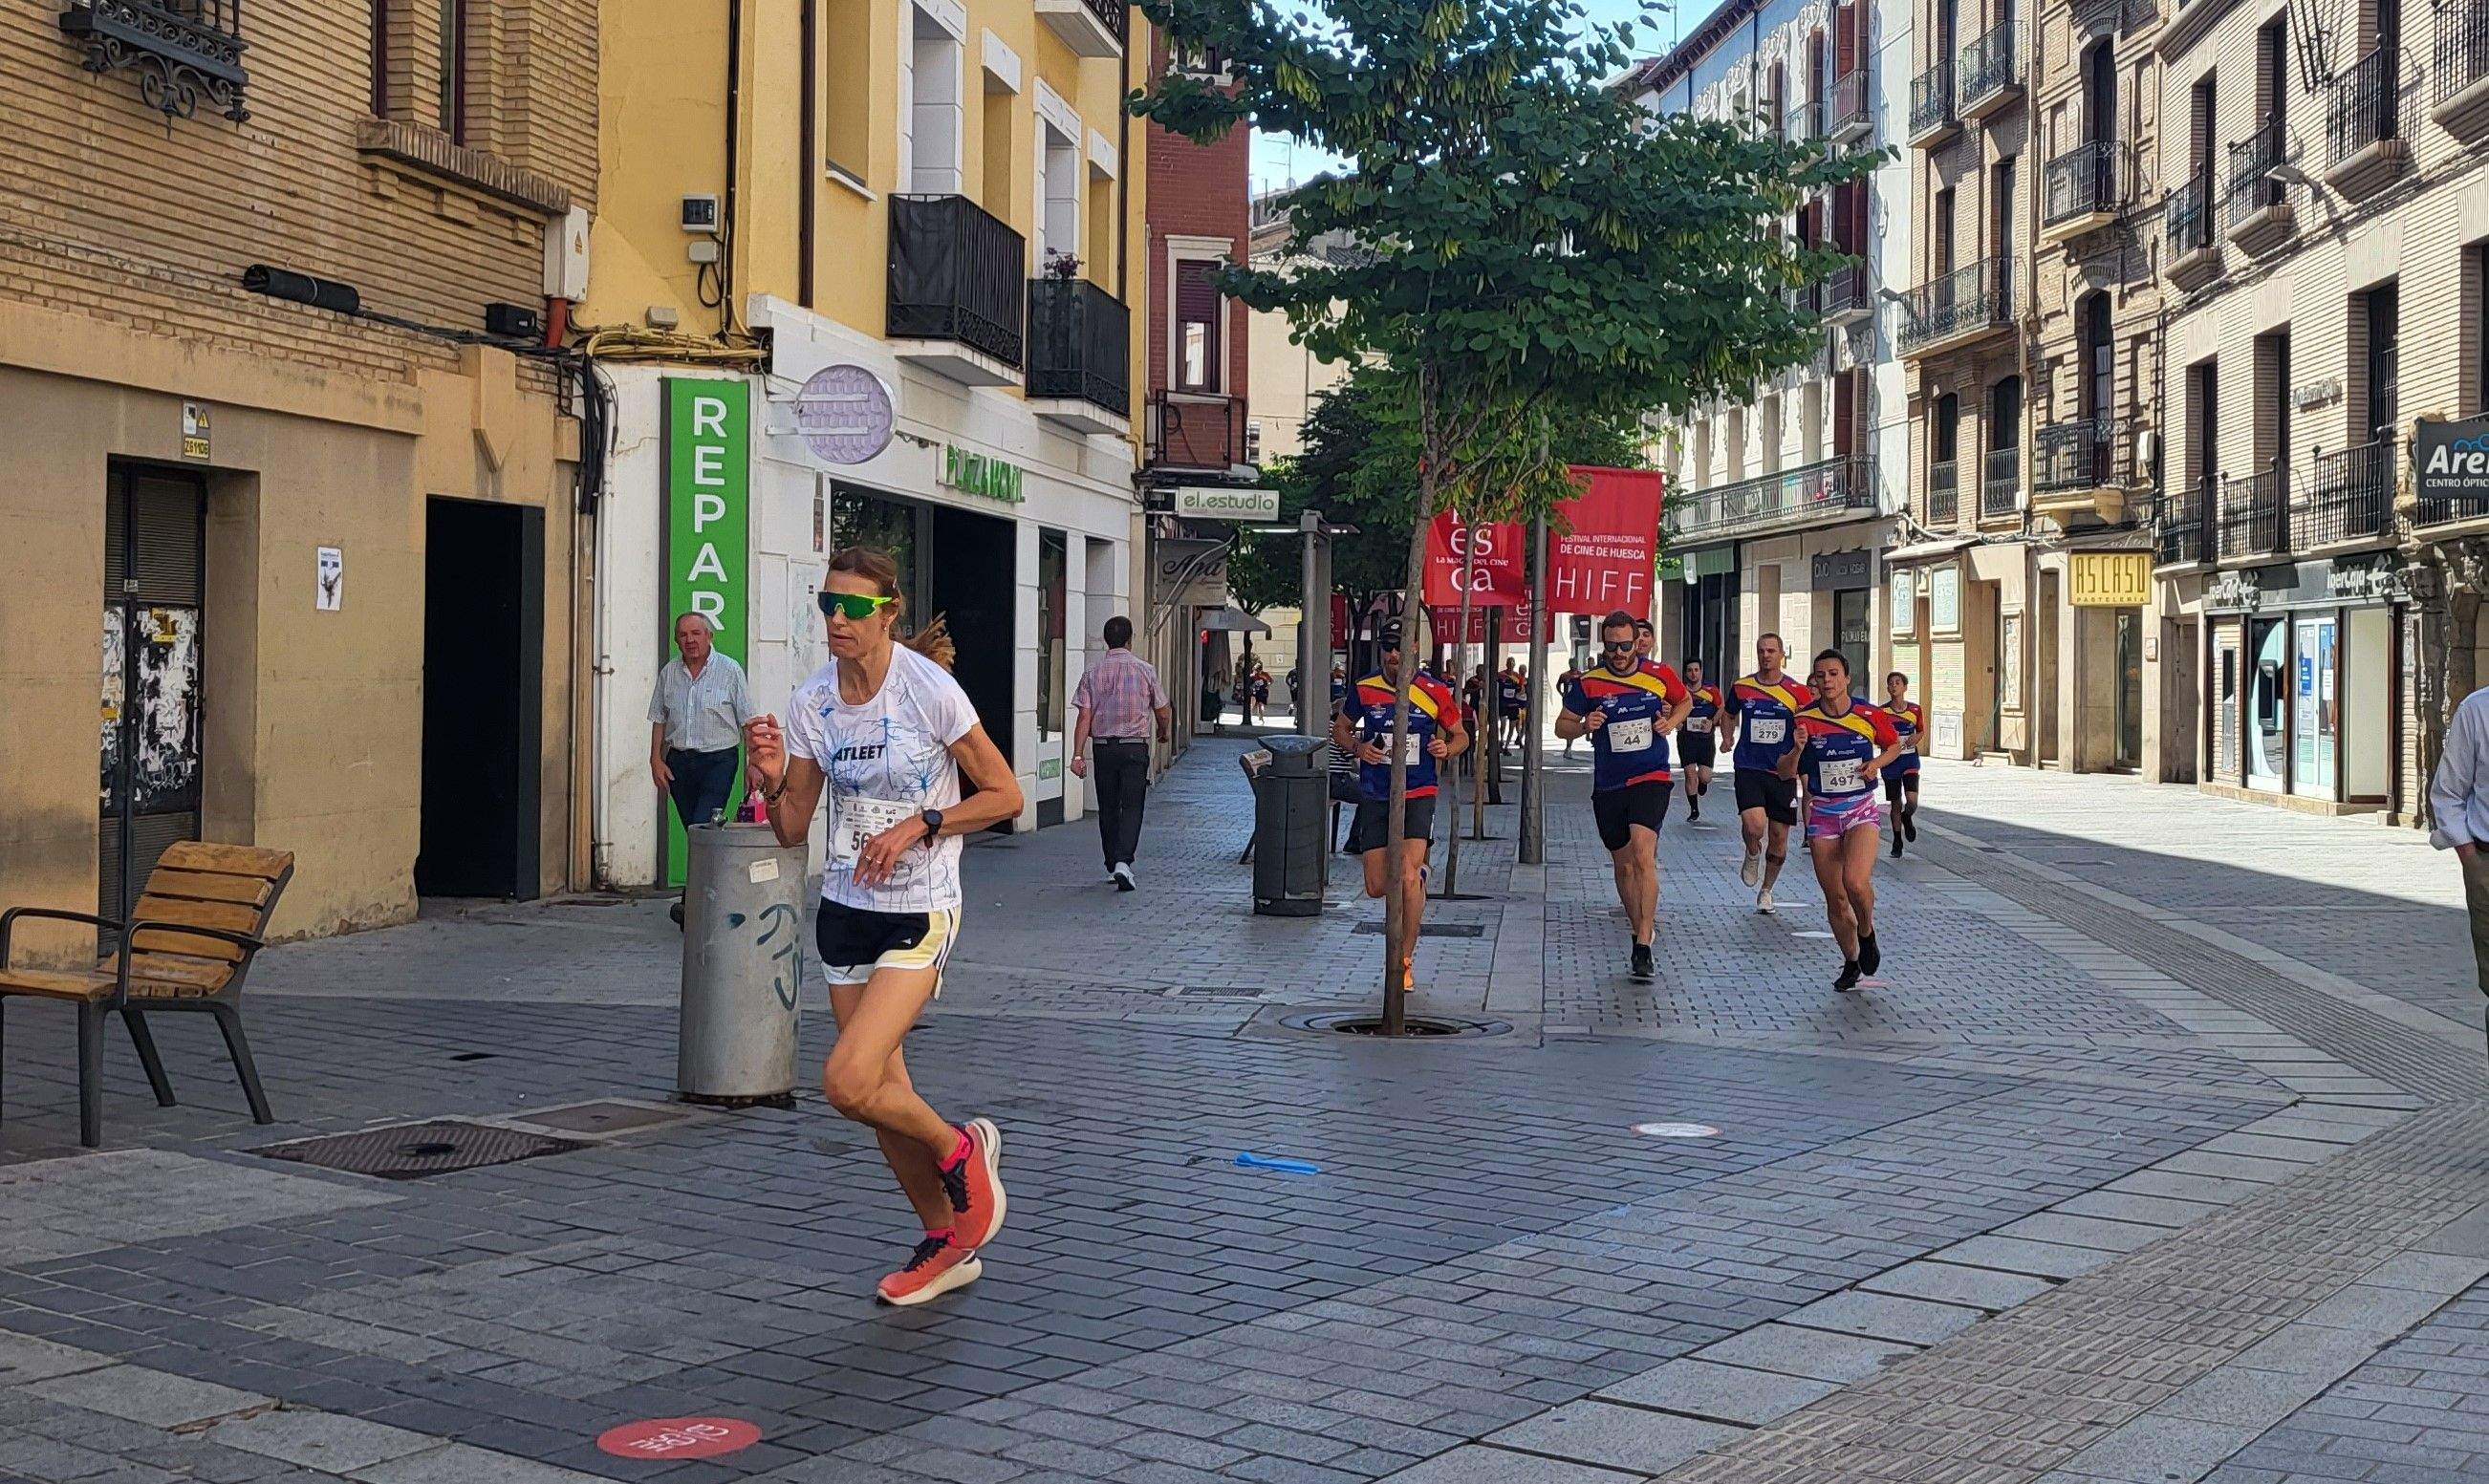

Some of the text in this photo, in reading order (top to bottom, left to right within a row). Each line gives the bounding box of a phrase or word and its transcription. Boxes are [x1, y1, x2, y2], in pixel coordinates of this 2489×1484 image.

[2426, 444, 2489, 474] Are
[2426, 478, 2461, 487] CENTRO
[1184, 491, 1274, 510] el.estudio
[1592, 535, 1646, 544] INTERNACIONAL
[1560, 544, 1646, 560] DE CINE DE HUESCA
[2076, 557, 2146, 593] ASCASO
[1556, 567, 1644, 604] HIFF
[1624, 735, 1640, 745] 44
[1759, 731, 1779, 740] 279
[833, 744, 886, 762] ATLEET
[1829, 776, 1854, 787] 497
